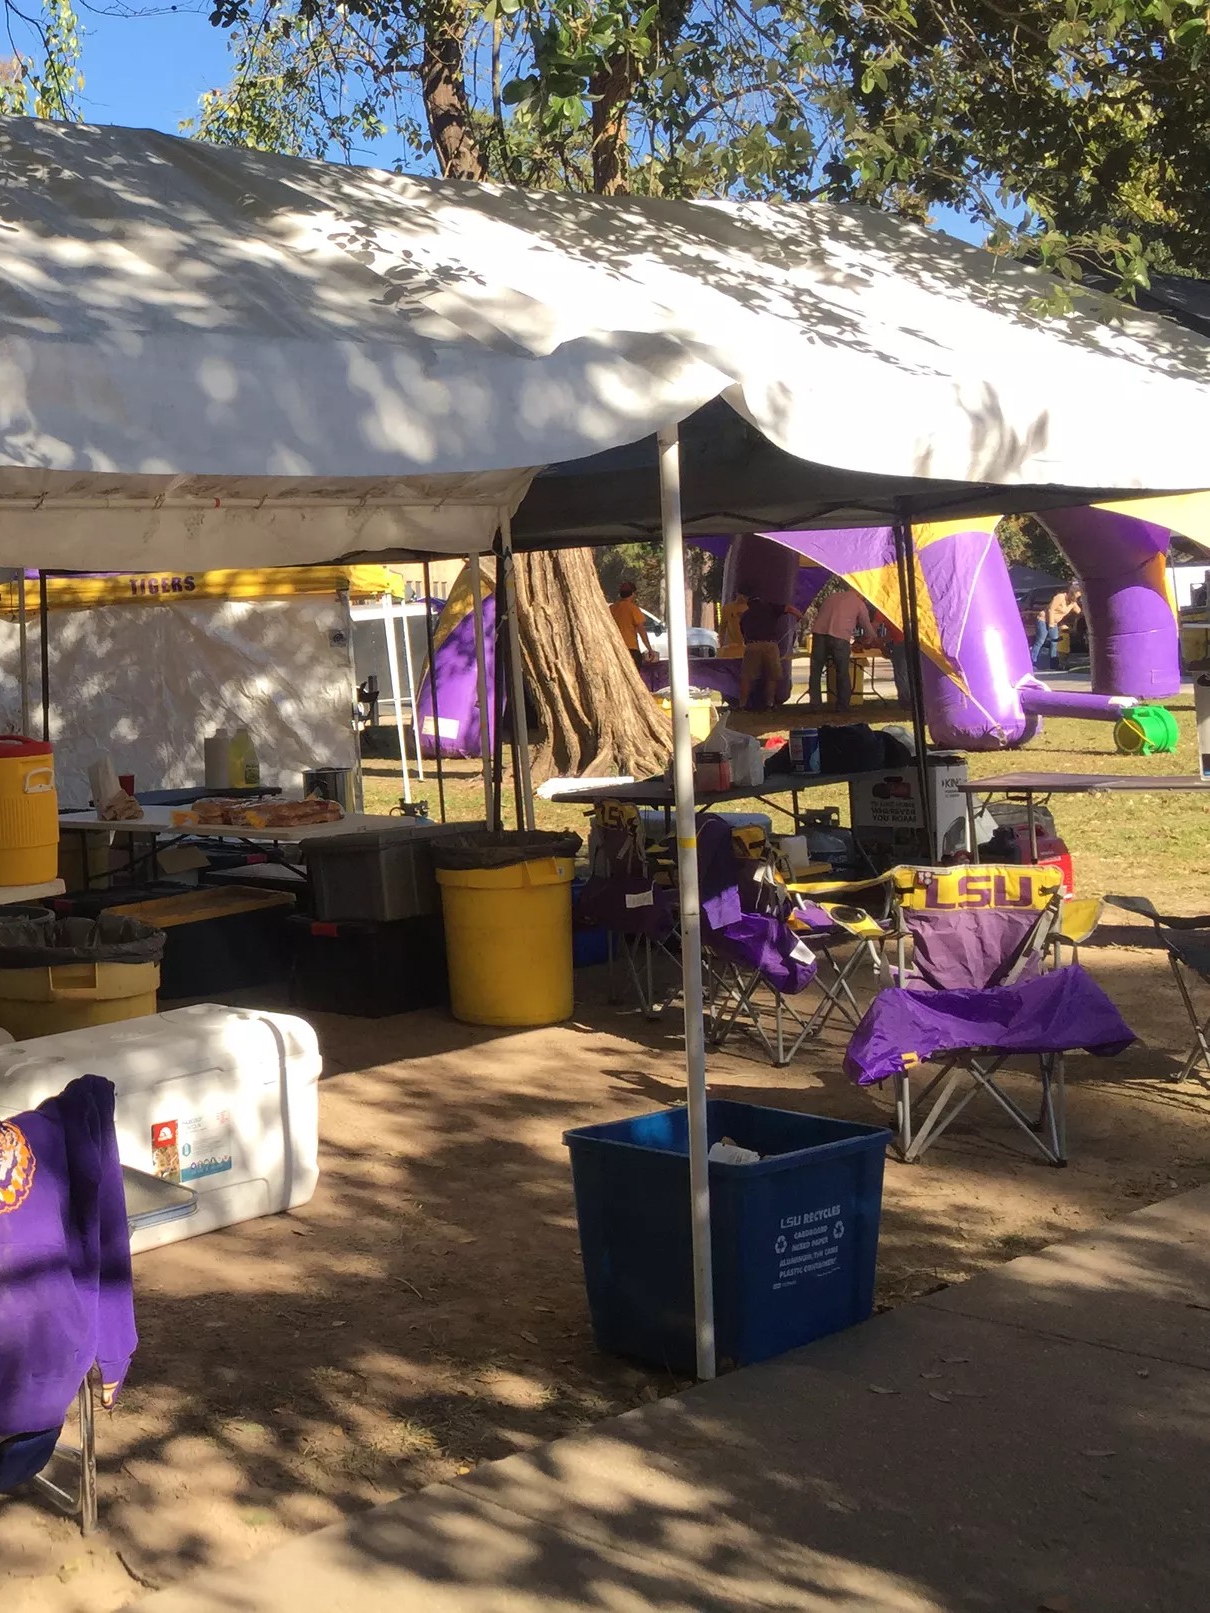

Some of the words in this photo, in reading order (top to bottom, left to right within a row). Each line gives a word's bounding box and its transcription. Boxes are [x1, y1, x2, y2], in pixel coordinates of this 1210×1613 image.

[130, 575, 196, 595] TIGERS
[872, 814, 889, 822] YOU
[925, 875, 1032, 909] LSU
[781, 1215, 801, 1229] LSU
[803, 1205, 841, 1224] RECYCLES
[779, 1267, 803, 1279] PLASTIC
